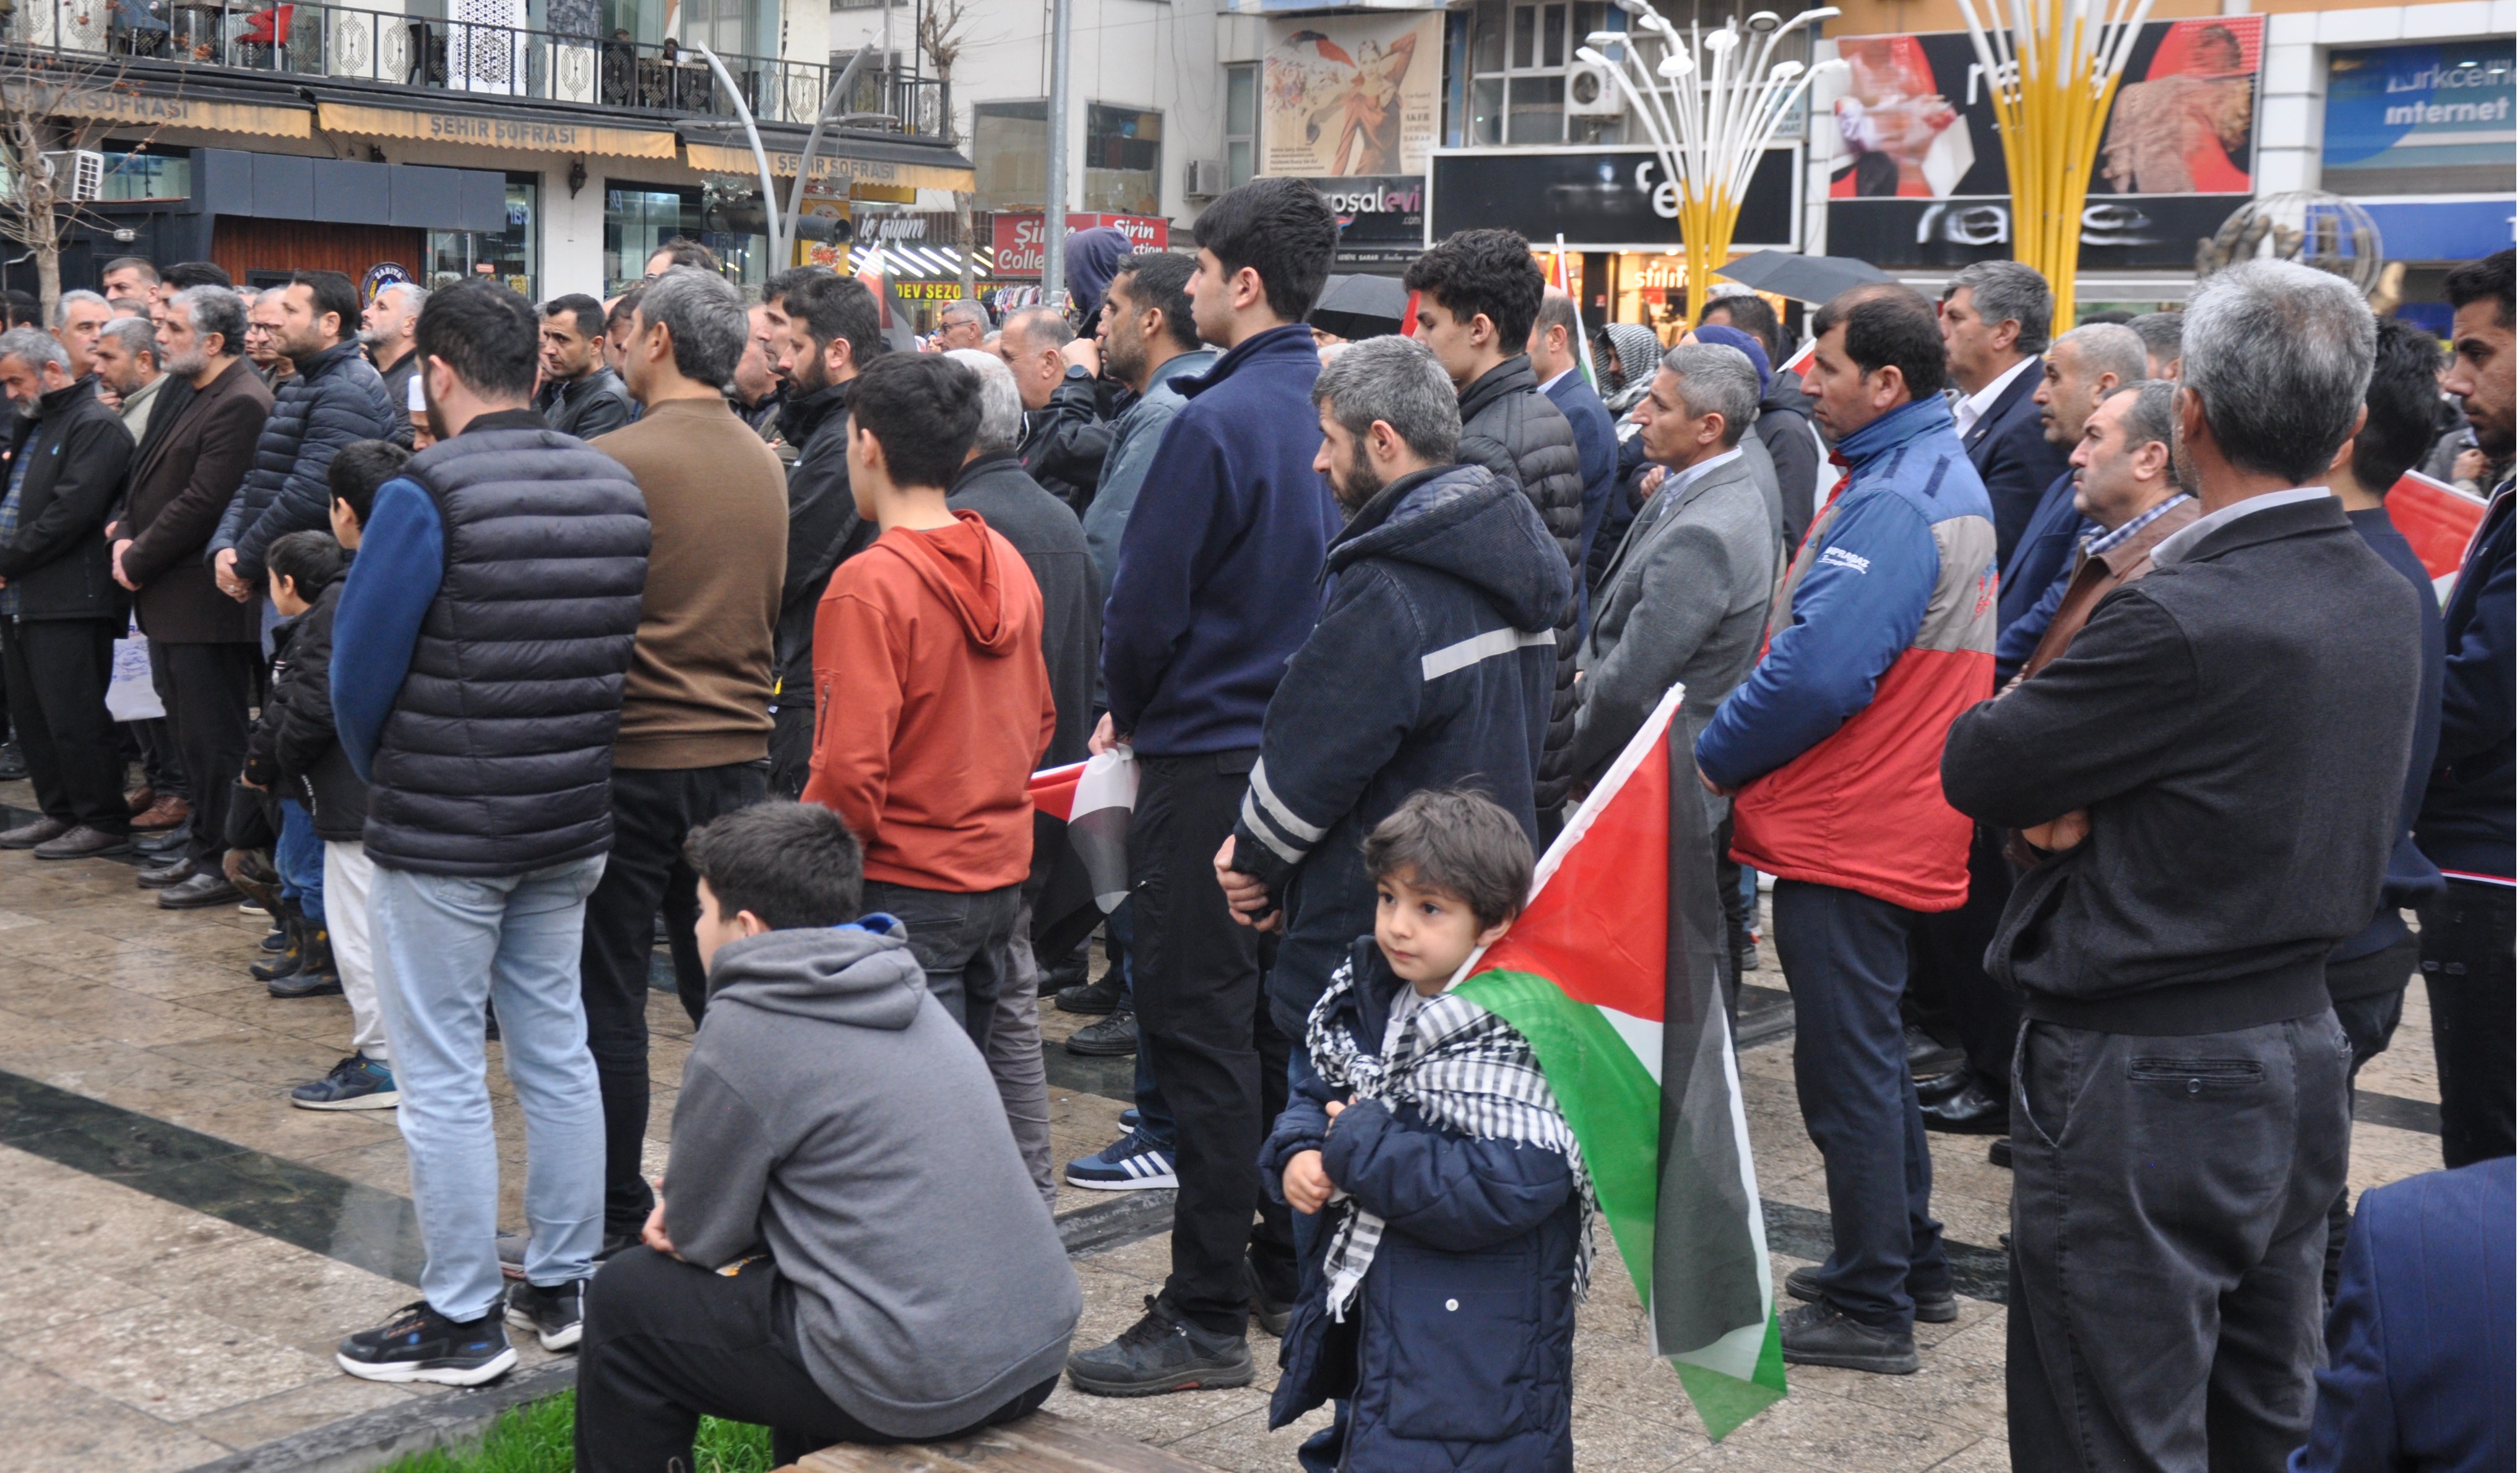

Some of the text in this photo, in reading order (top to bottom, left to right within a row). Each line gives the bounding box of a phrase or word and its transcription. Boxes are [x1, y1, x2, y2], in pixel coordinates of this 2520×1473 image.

[431, 115, 576, 144] ŞEHİR SOFRASI
[895, 283, 921, 299] DEV
[926, 283, 962, 300] SEZO
